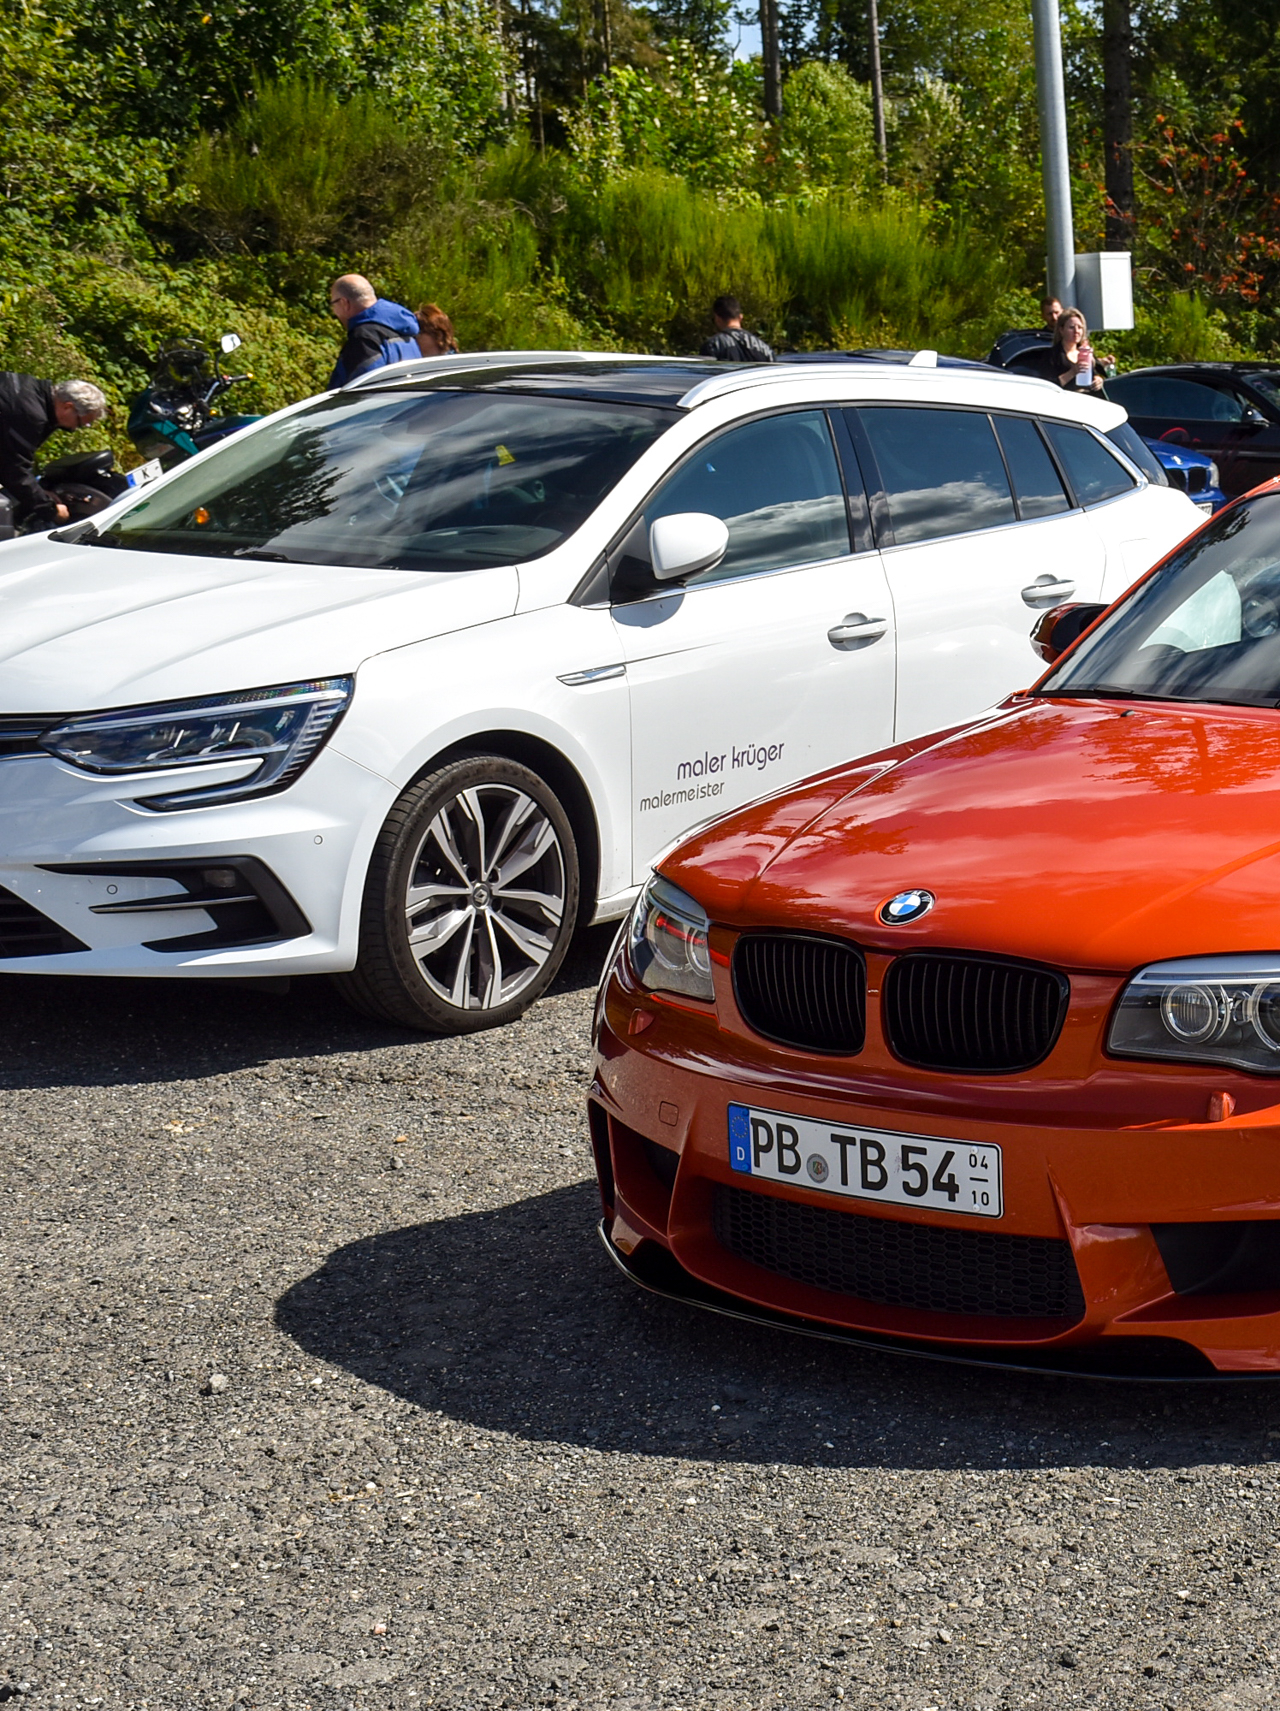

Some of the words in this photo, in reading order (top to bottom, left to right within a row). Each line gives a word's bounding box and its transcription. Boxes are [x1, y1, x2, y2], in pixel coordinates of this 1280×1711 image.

[677, 751, 727, 780] maler
[732, 743, 785, 771] krüger
[639, 782, 725, 812] malermeister
[736, 1146, 746, 1162] D
[750, 1117, 802, 1175] PB
[830, 1133, 889, 1191] TB
[901, 1145, 960, 1203] 54
[968, 1153, 989, 1170] 04
[971, 1190, 990, 1206] 10
